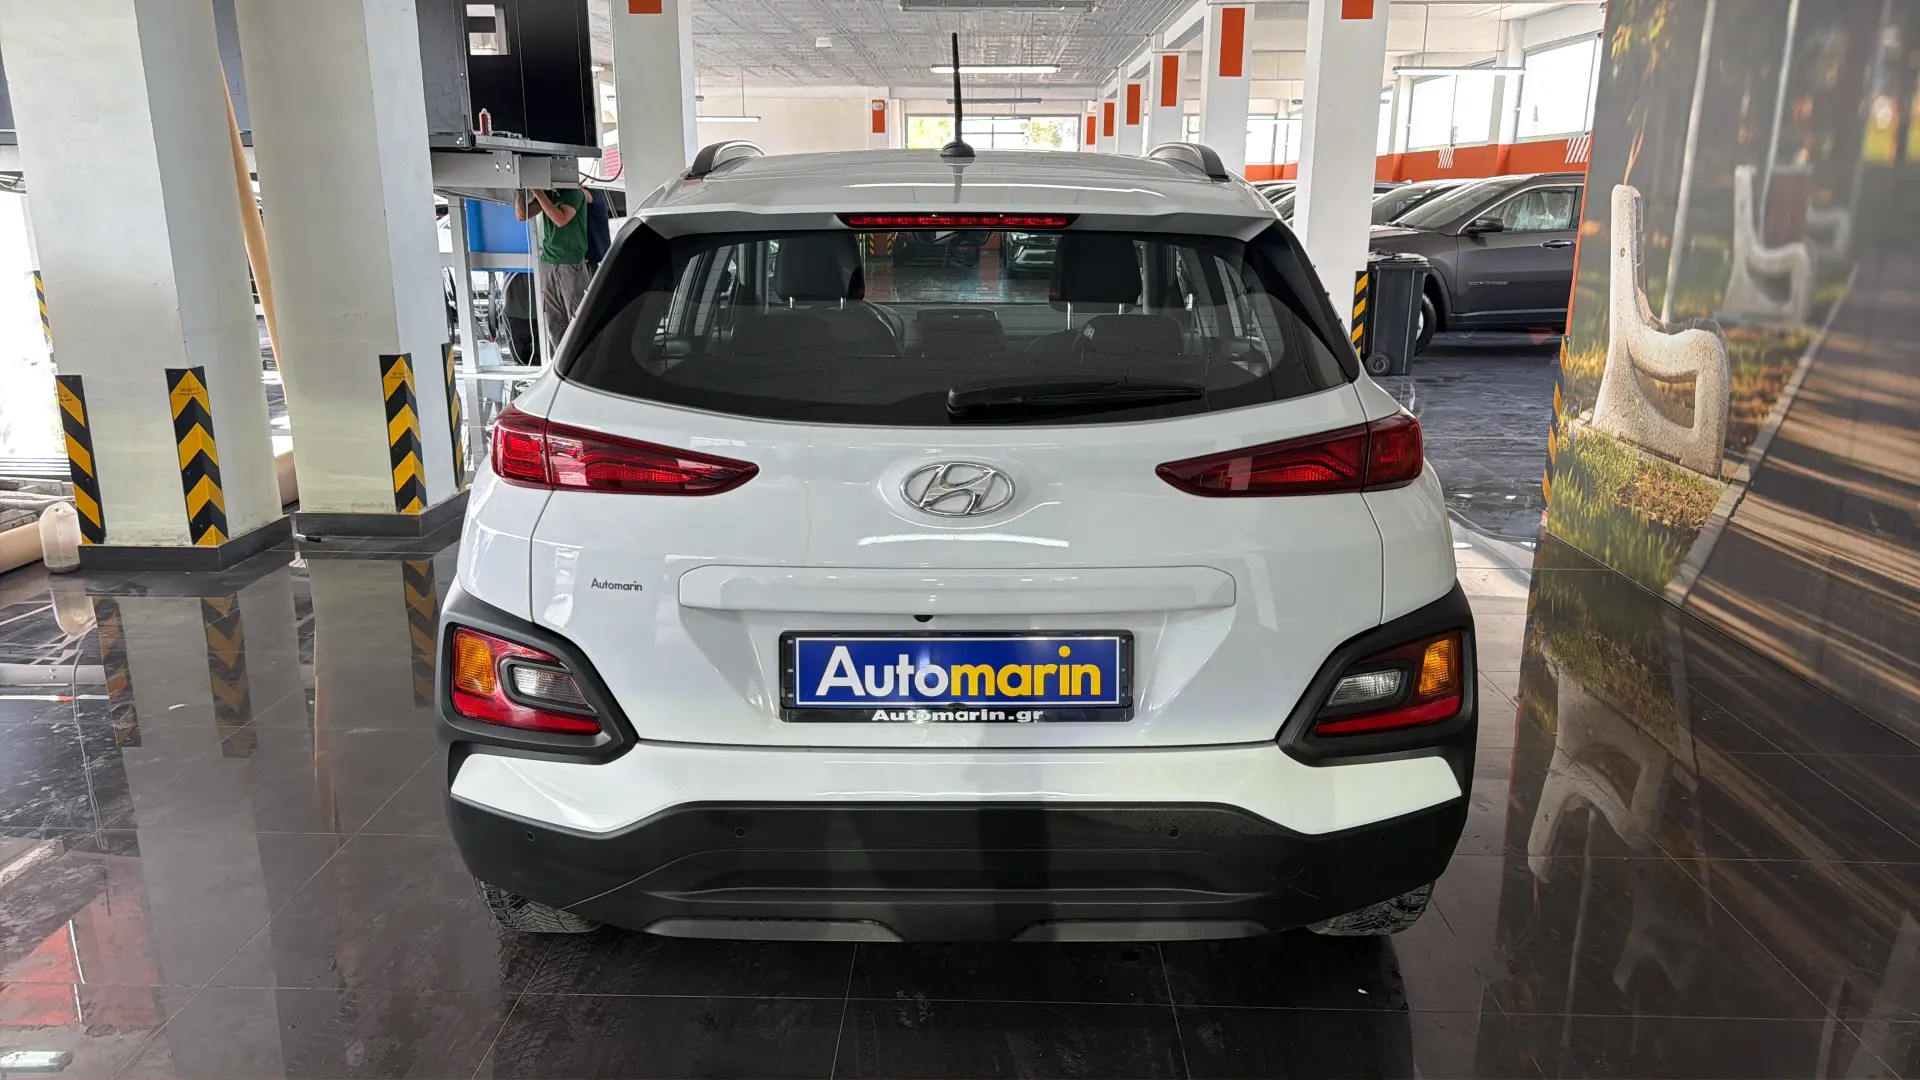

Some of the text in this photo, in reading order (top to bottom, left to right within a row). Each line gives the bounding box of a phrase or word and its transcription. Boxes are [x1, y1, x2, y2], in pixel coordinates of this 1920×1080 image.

[591, 578, 643, 592] Automarin
[815, 645, 1101, 697] Automarin
[872, 709, 1044, 723] Automarin.gr
